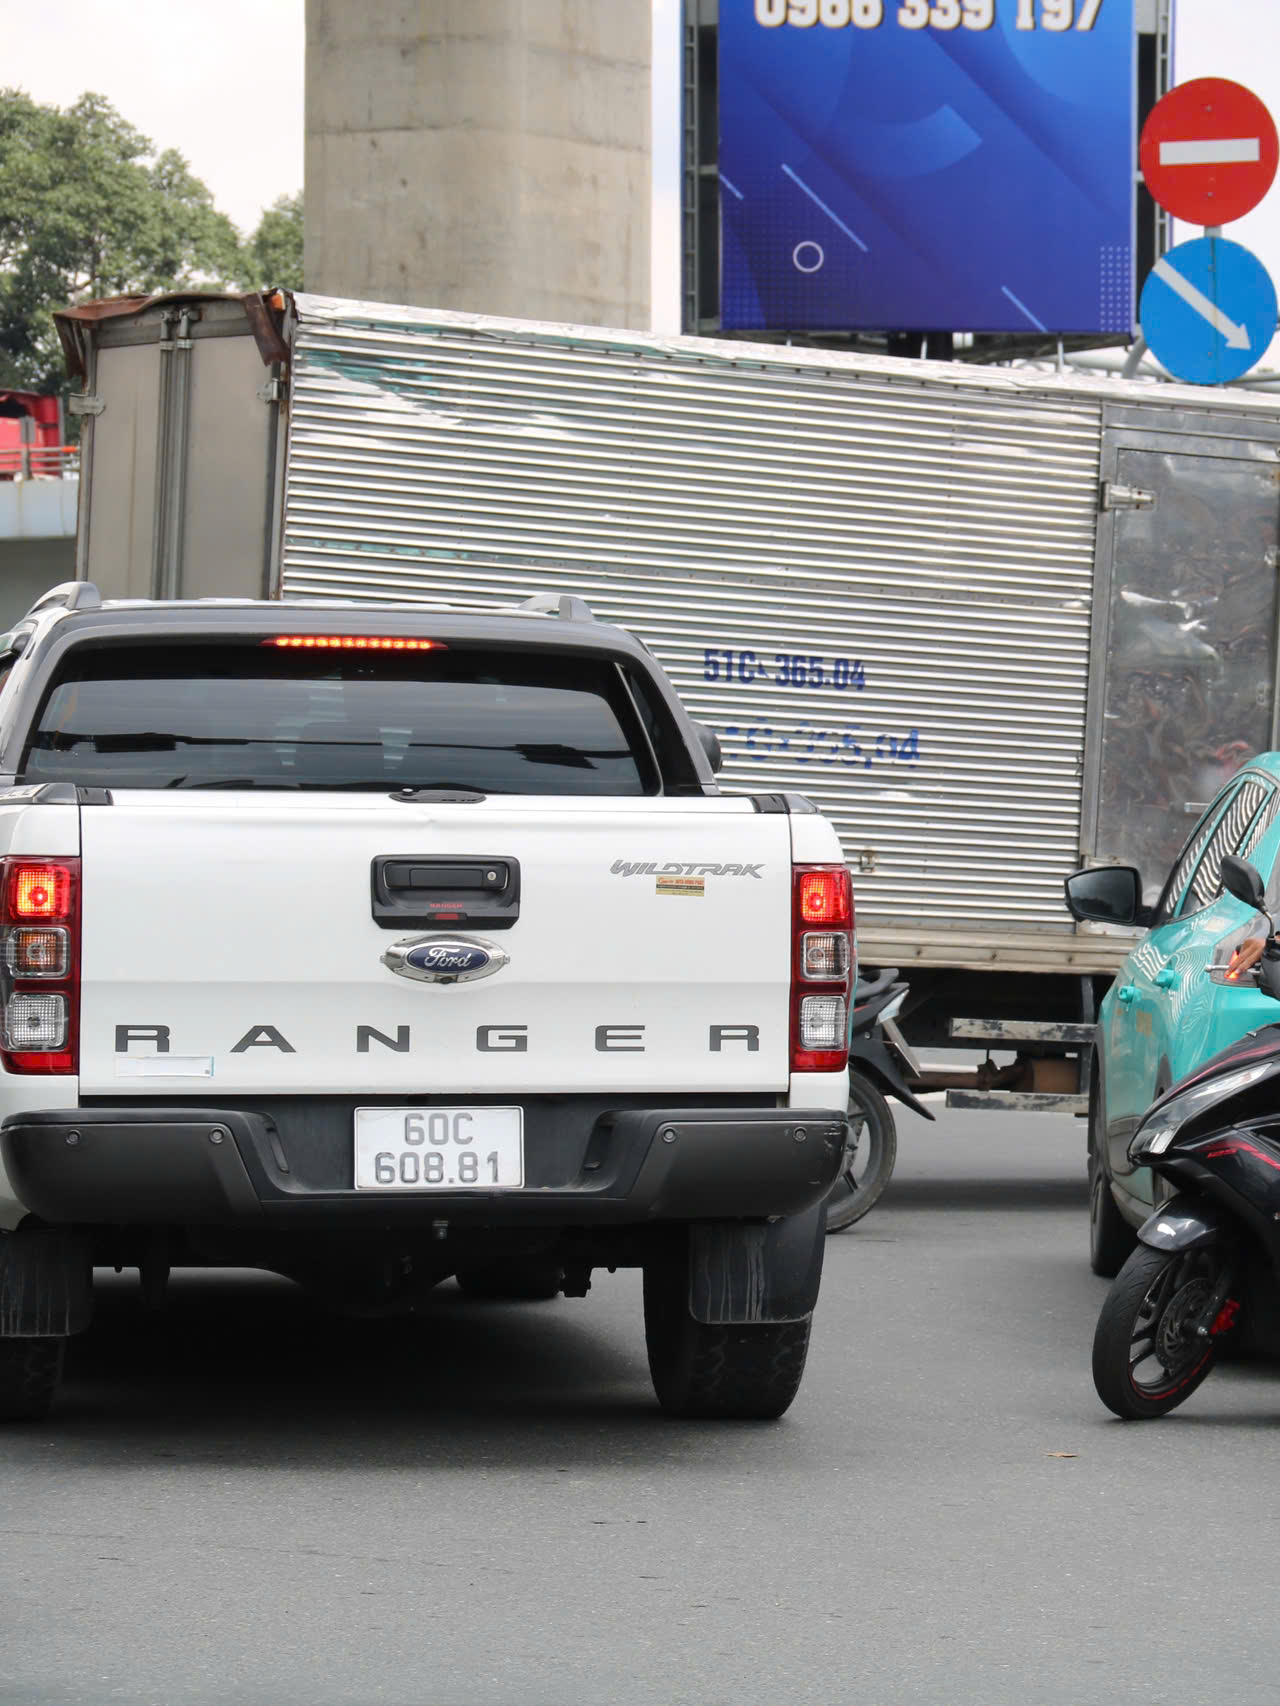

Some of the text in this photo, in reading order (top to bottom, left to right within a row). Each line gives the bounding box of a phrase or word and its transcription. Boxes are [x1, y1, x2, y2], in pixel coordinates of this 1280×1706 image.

[609, 859, 767, 879] WILDTRAK
[424, 947, 472, 968] Ford
[115, 1025, 759, 1053] RANGER
[404, 1112, 474, 1146] 60C
[375, 1151, 499, 1184] 608.81
